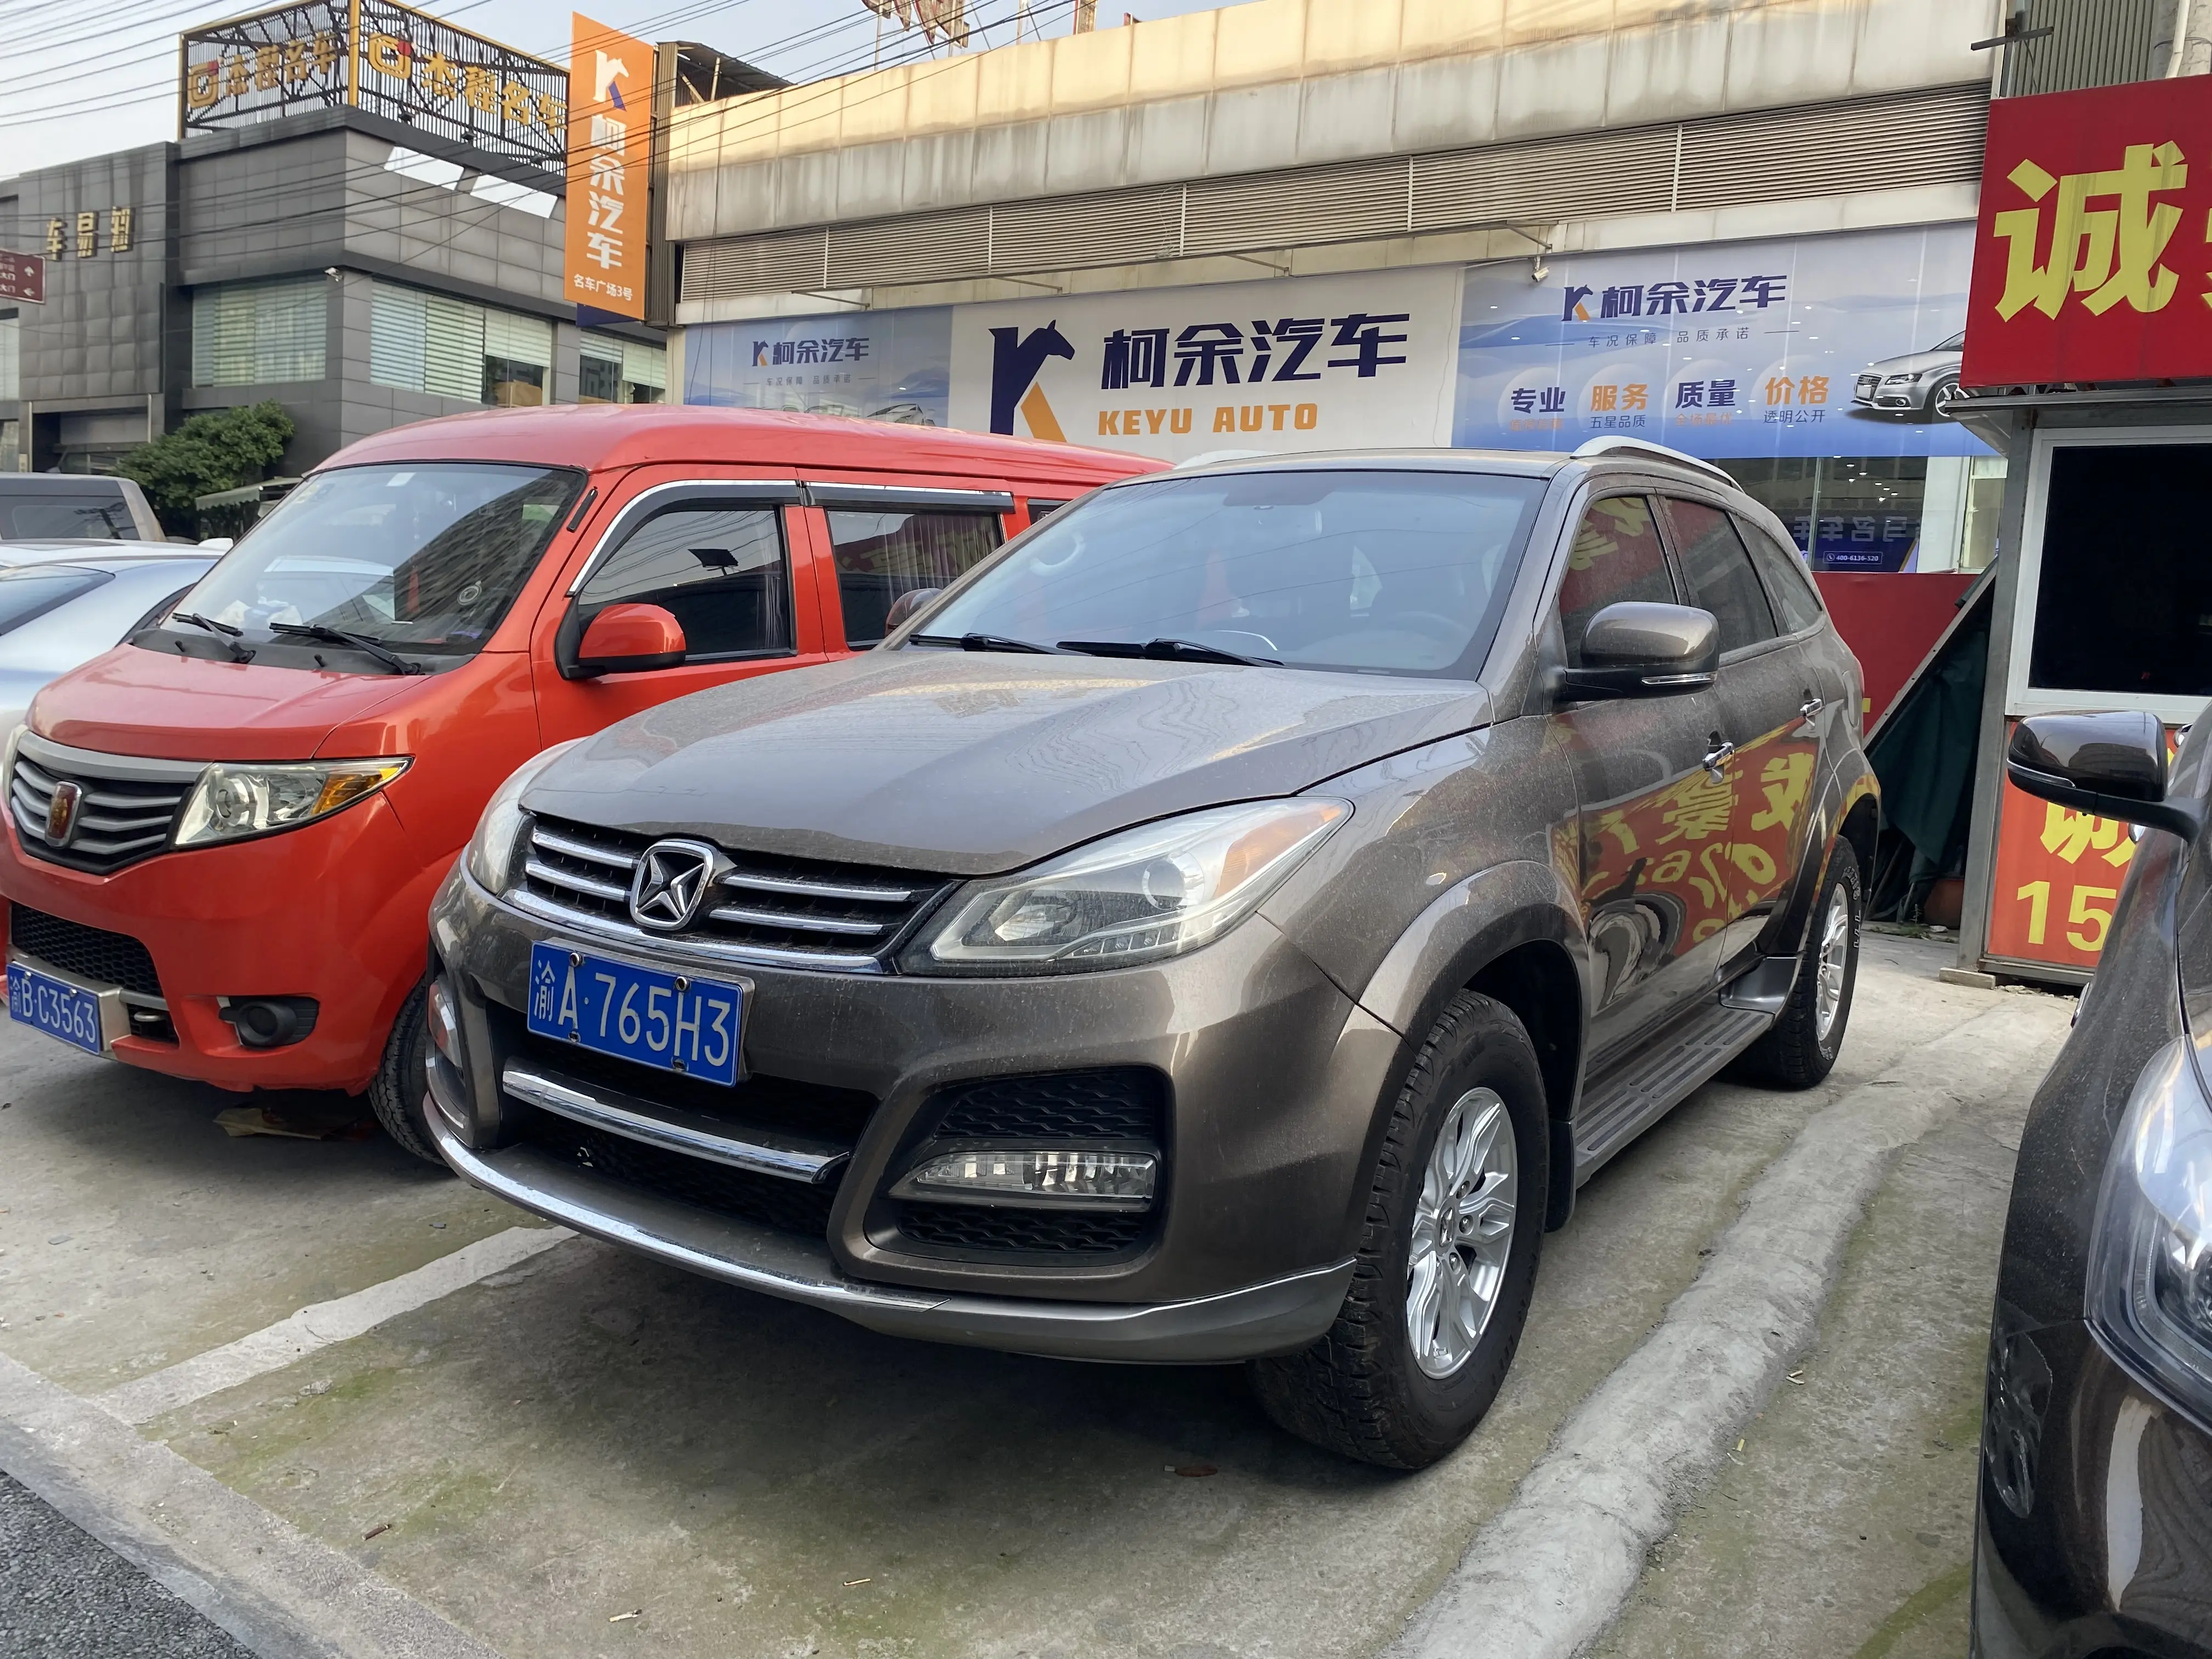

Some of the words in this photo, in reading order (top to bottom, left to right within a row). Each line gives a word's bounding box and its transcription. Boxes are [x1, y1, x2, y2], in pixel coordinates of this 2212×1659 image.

[586, 114, 627, 269] 柯余汽车
[1994, 140, 2212, 323] 诚
[574, 274, 633, 301] 名车广场3号
[1600, 275, 1787, 319] 柯余汽车
[772, 338, 869, 365] 柯余汽车
[1101, 313, 1410, 390] 柯余汽车
[1589, 332, 1657, 348] 车况保障
[1677, 328, 1750, 343] 品质承诺
[1511, 387, 1566, 414] 专业
[1591, 383, 1649, 412] 服务
[1675, 380, 1735, 409] 质量
[1765, 376, 1829, 405] 价格
[1099, 408, 1192, 436] KEYU
[1214, 403, 1317, 433] AUTO
[1589, 414, 1646, 428] 五星品质
[1763, 409, 1825, 424] 透明公开
